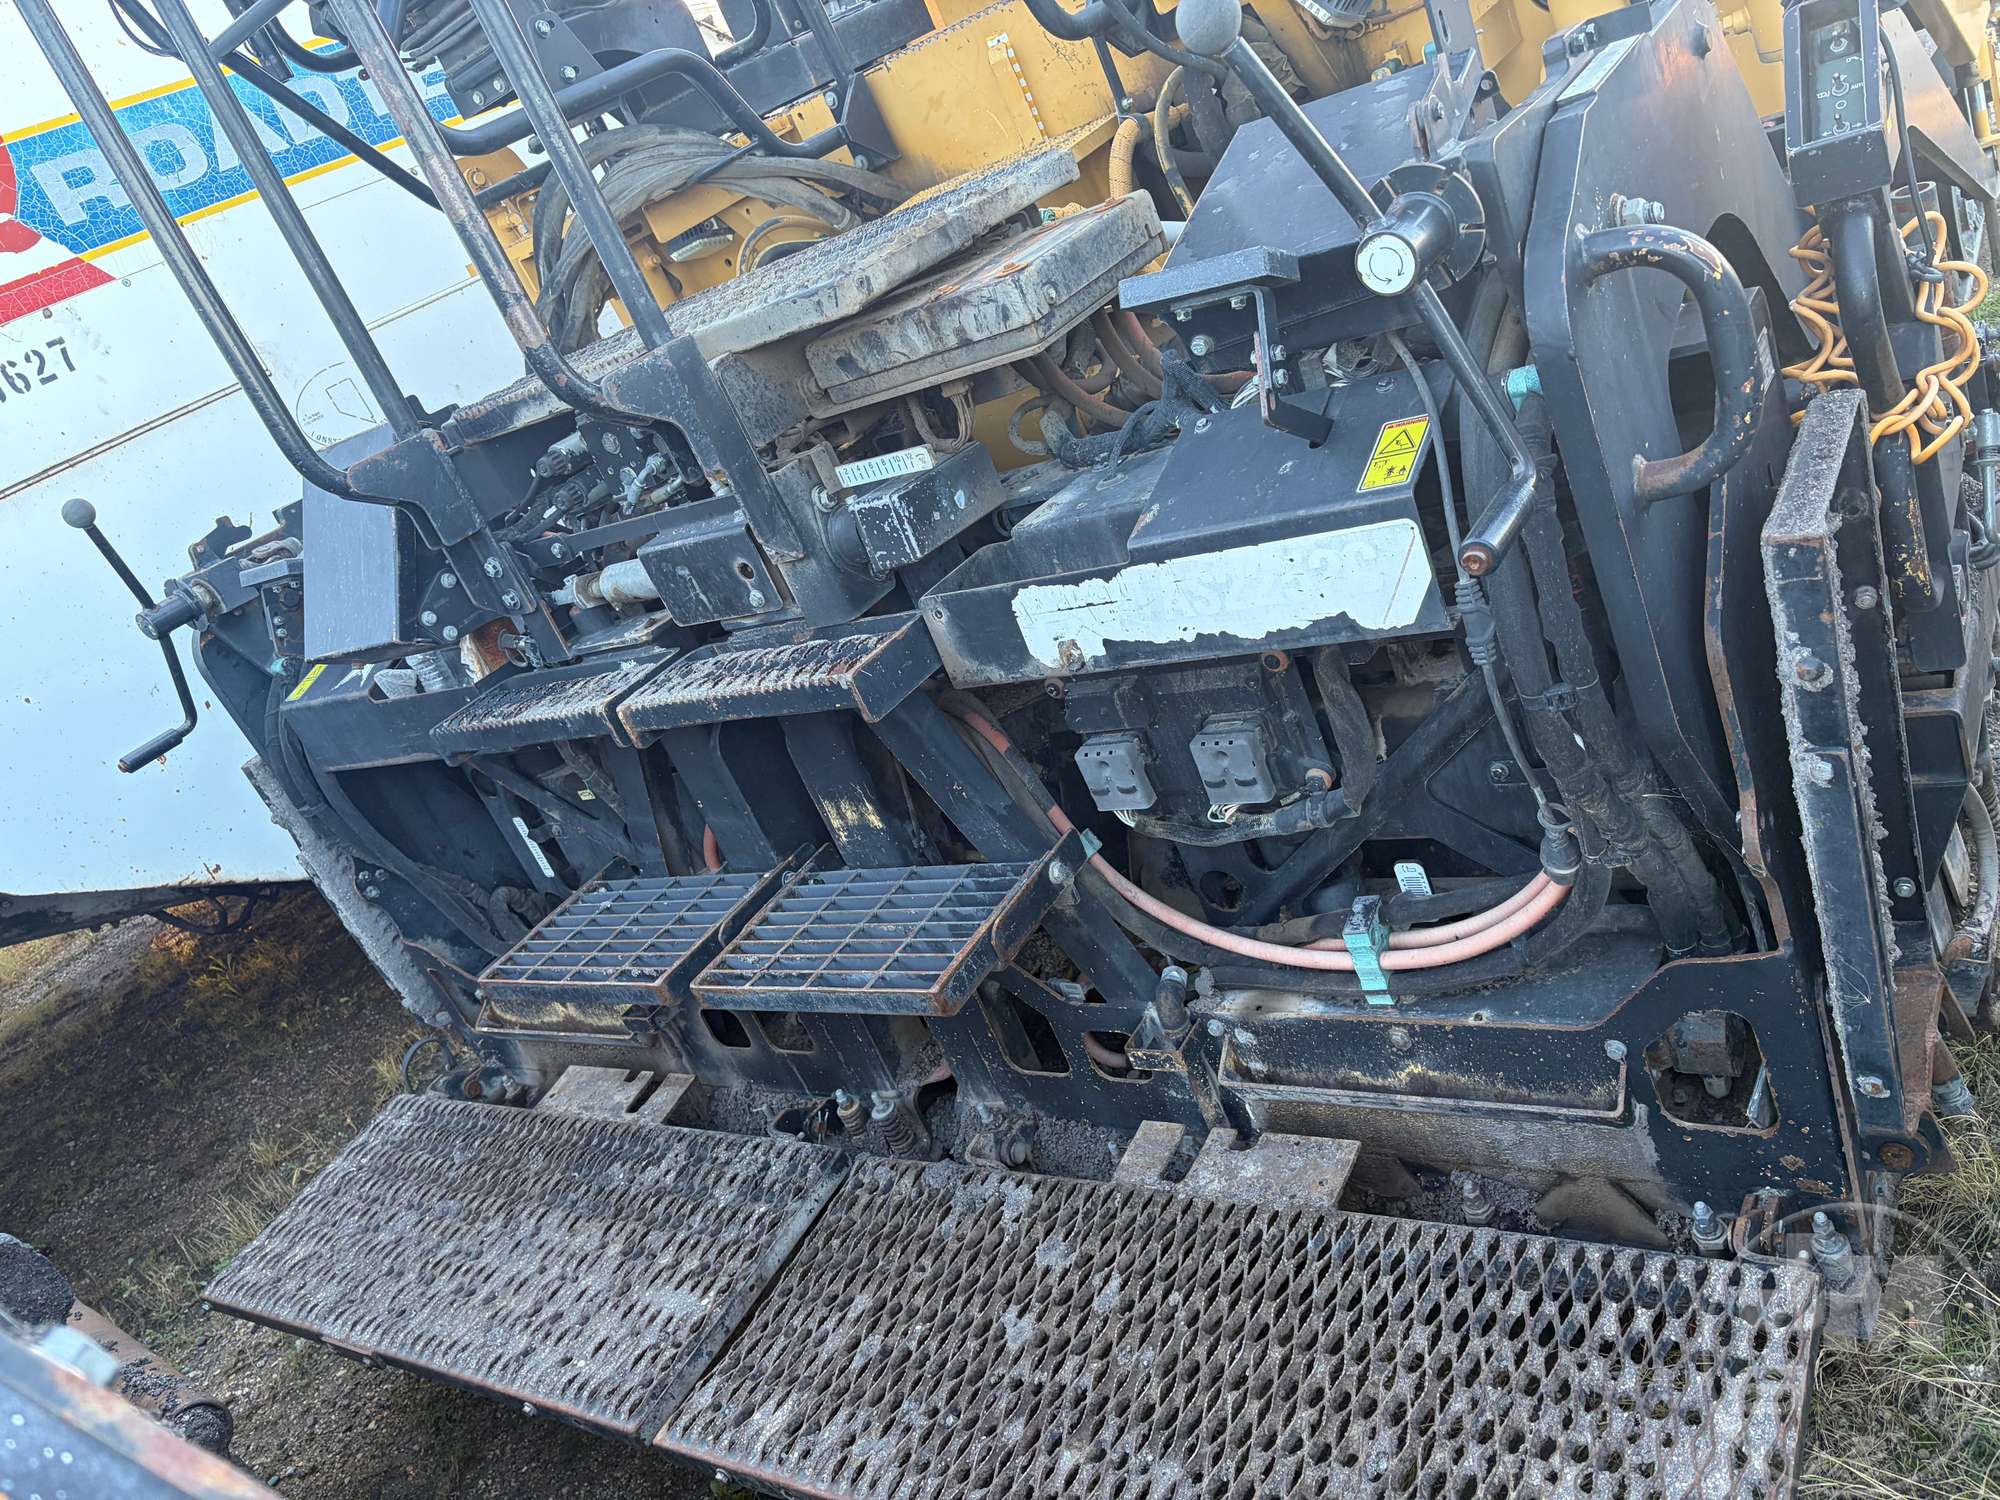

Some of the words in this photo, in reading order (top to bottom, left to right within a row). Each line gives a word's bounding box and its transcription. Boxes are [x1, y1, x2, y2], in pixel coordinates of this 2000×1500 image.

[0, 335, 77, 403] 627
[843, 467, 849, 475] 2
[892, 455, 901, 463] 10
